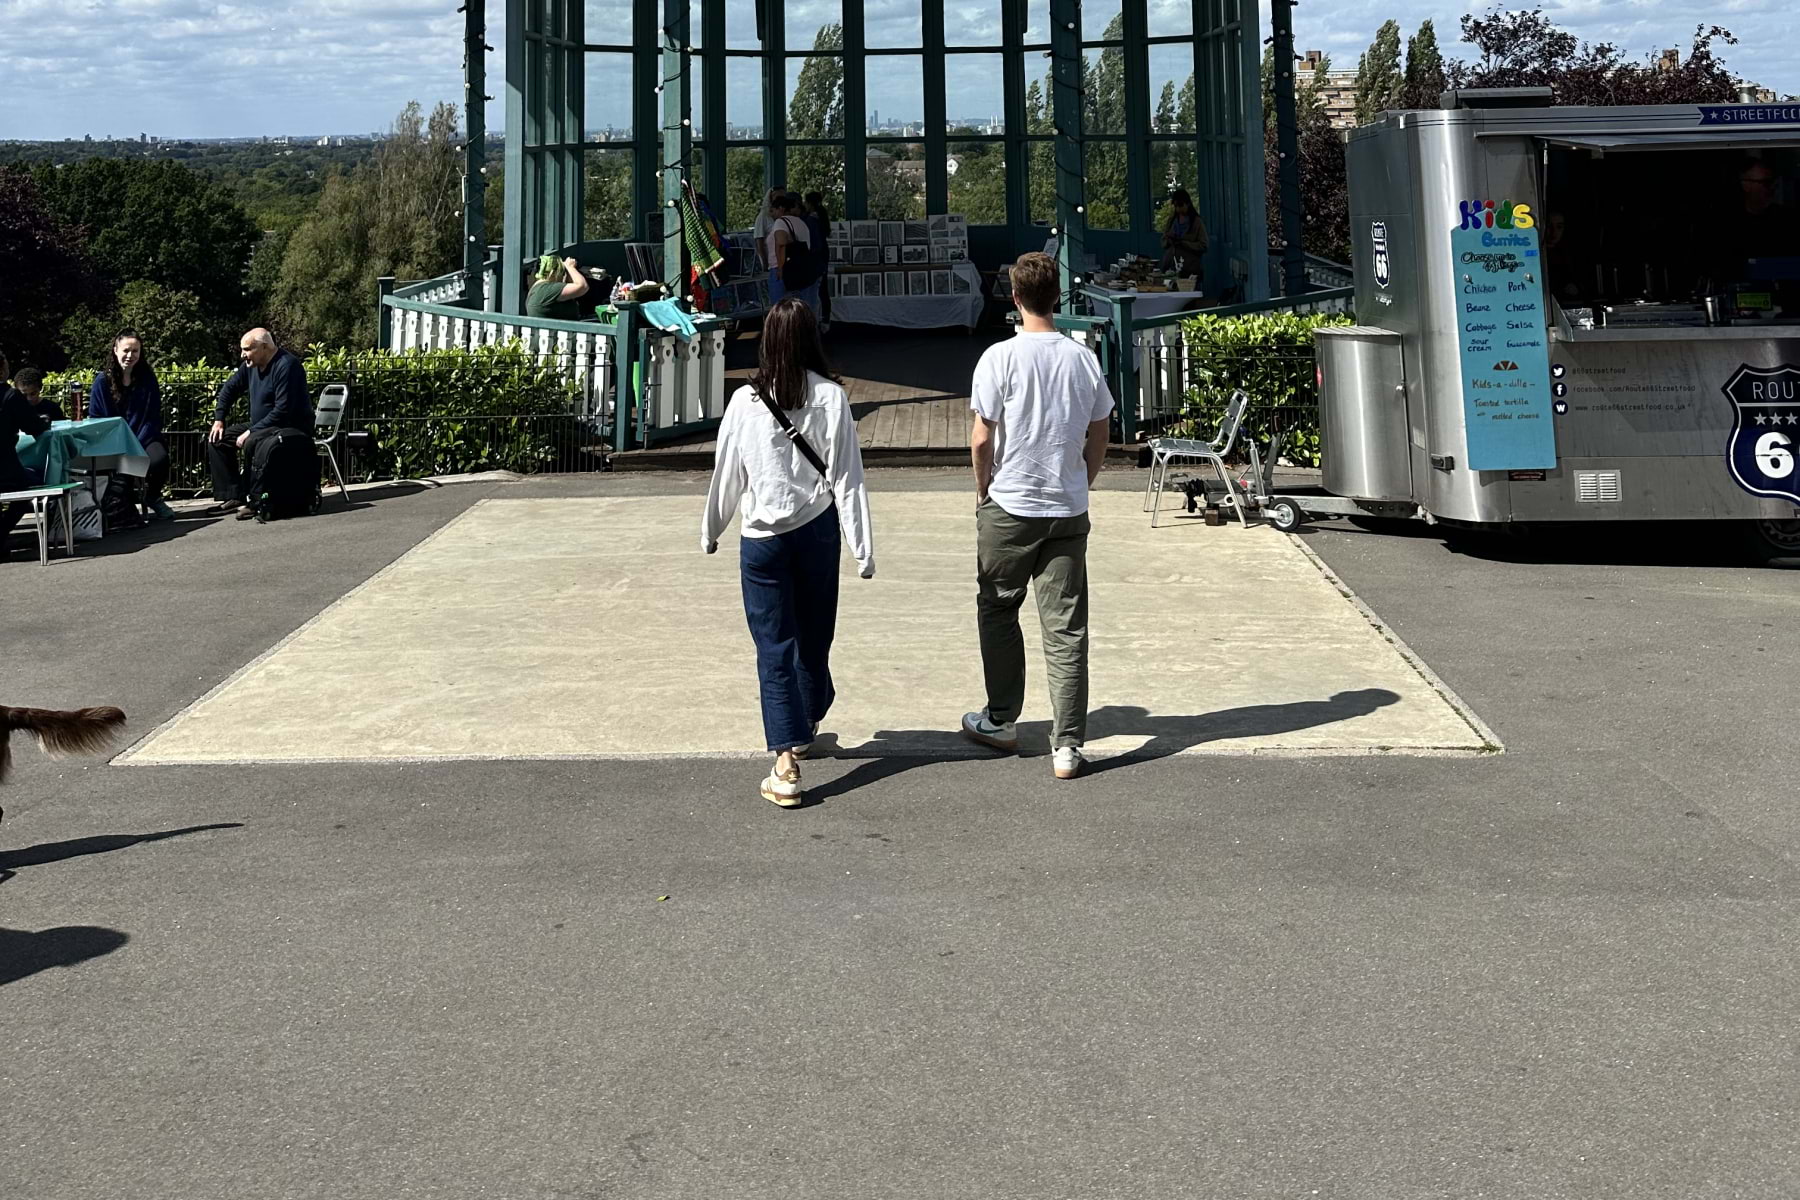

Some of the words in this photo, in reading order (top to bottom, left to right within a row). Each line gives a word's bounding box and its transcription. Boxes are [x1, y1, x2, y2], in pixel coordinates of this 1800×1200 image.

[1722, 108, 1800, 121] STREETFOO
[1459, 200, 1535, 230] Kids
[1375, 253, 1388, 279] 66
[1464, 284, 1497, 294] Chicken
[1508, 281, 1527, 292] Pork
[1505, 303, 1536, 313] Cheese
[1465, 322, 1497, 334] Cabbage
[1506, 320, 1534, 330] Salsa
[1754, 431, 1800, 480] 6
